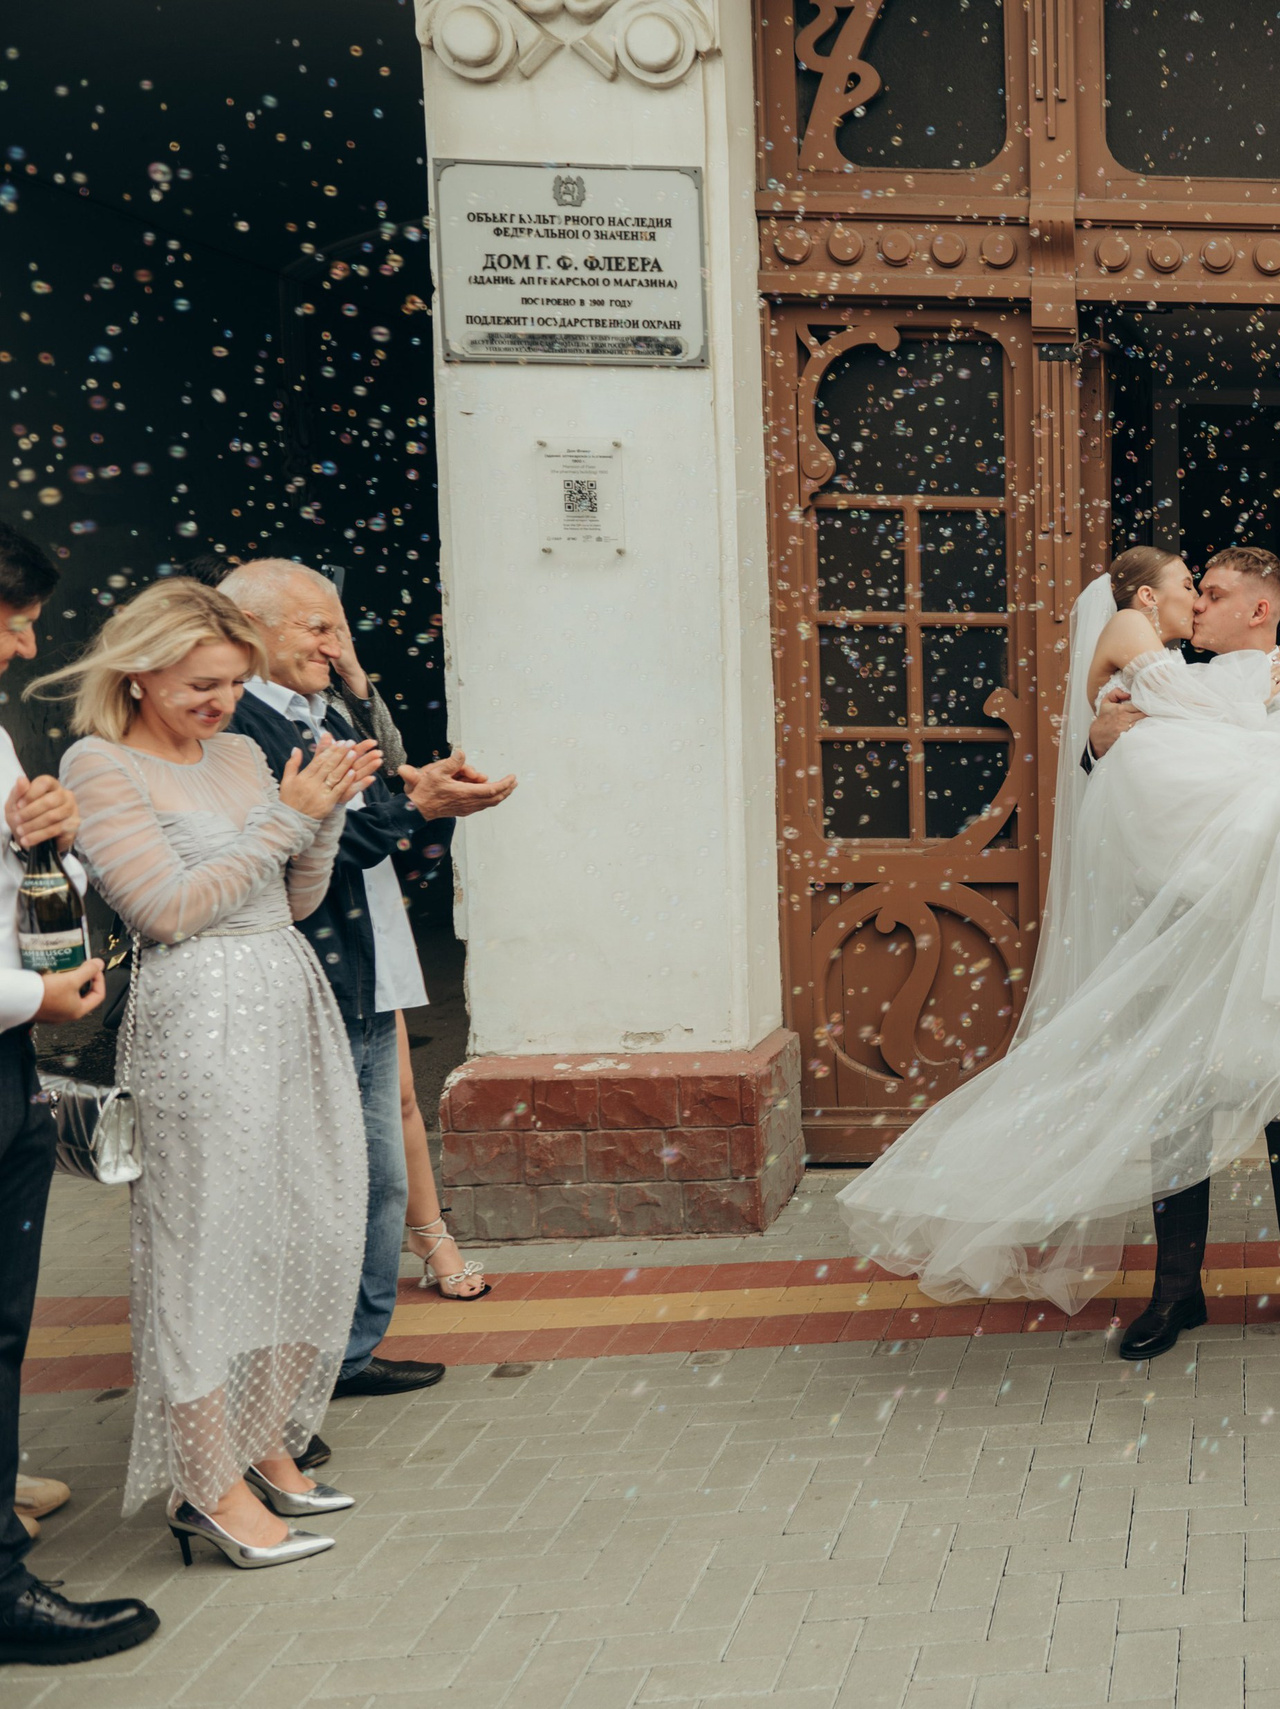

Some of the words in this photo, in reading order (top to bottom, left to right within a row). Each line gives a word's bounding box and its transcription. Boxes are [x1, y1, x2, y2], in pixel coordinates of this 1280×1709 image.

[608, 217, 672, 230] НАСЛЕДИЯ
[594, 230, 656, 242] ЗНАЧЕНИЯ
[482, 254, 530, 272] ДОМ
[536, 255, 551, 270] Г.
[556, 256, 578, 271] Ф.
[584, 255, 663, 273] ФЛЕЕРА
[614, 278, 678, 290] МАГАЗИНА)
[609, 299, 633, 309] ГОДУ
[465, 315, 527, 327] ПОДЛЕЖИТ
